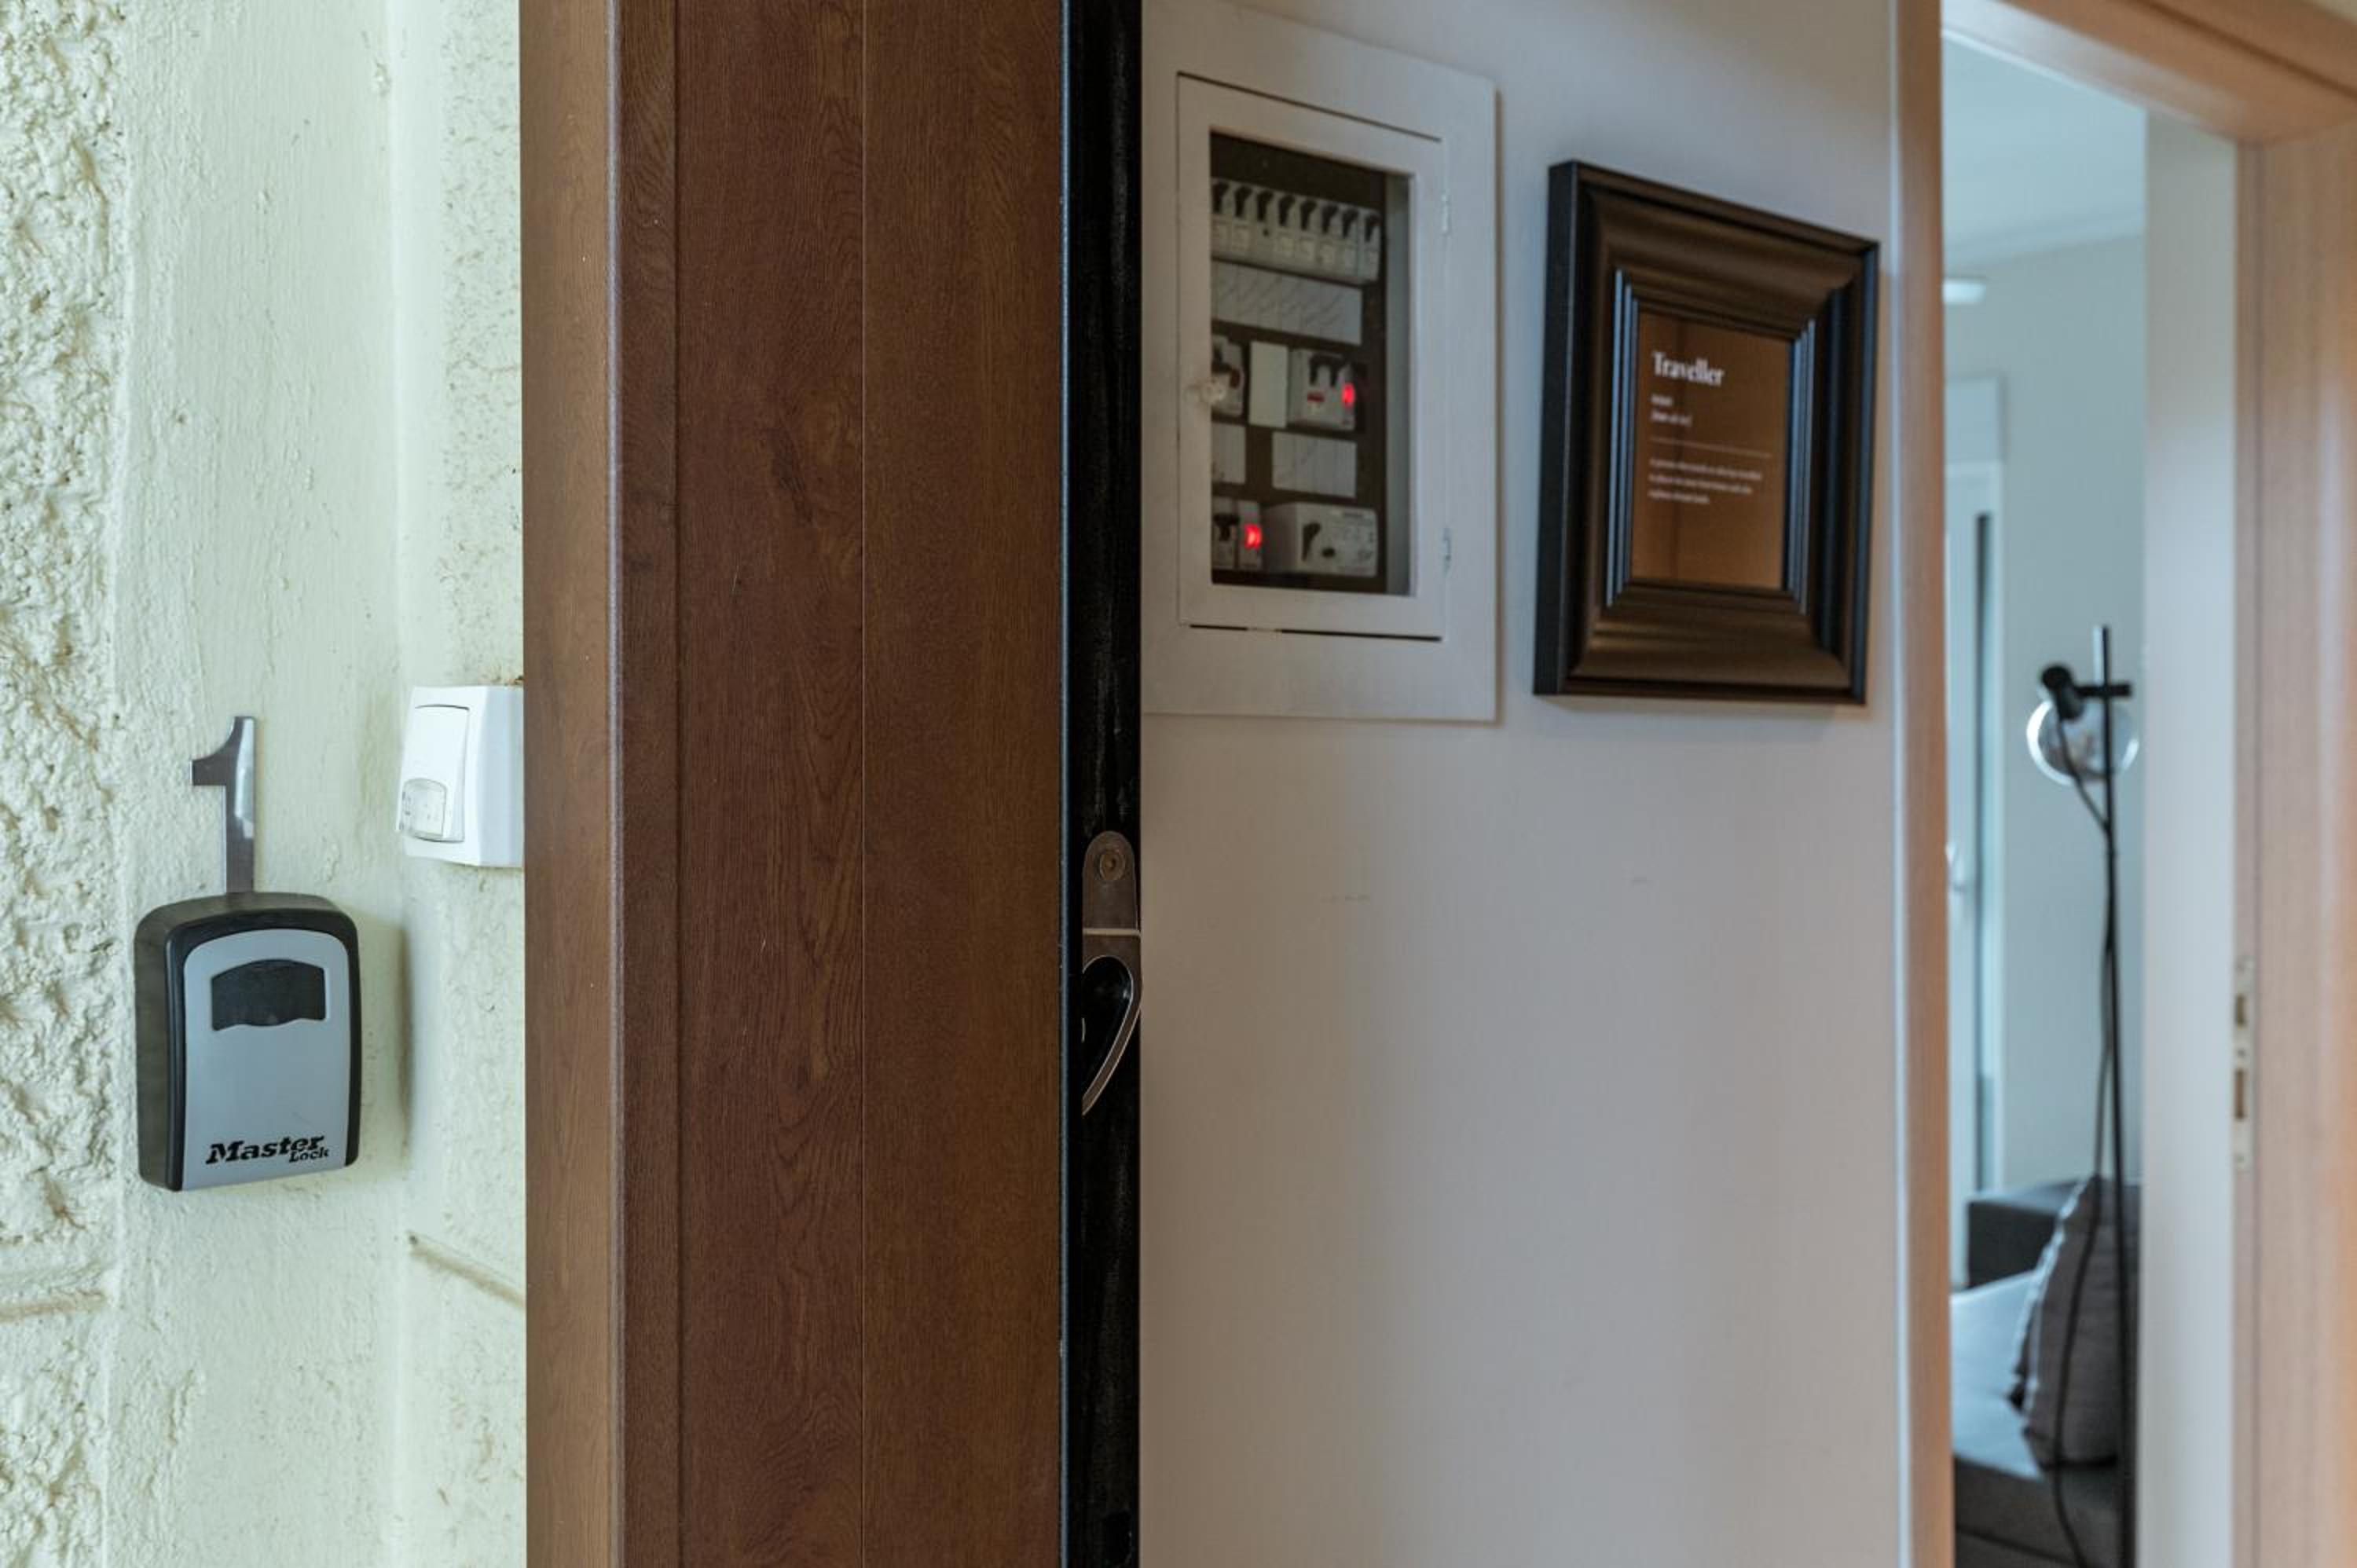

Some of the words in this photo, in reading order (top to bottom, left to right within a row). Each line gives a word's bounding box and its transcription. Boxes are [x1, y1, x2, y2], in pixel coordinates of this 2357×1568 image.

[1652, 352, 1724, 387] Traveller
[189, 716, 255, 894] 1
[206, 1136, 325, 1164] Master
[289, 1148, 329, 1163] Lock
